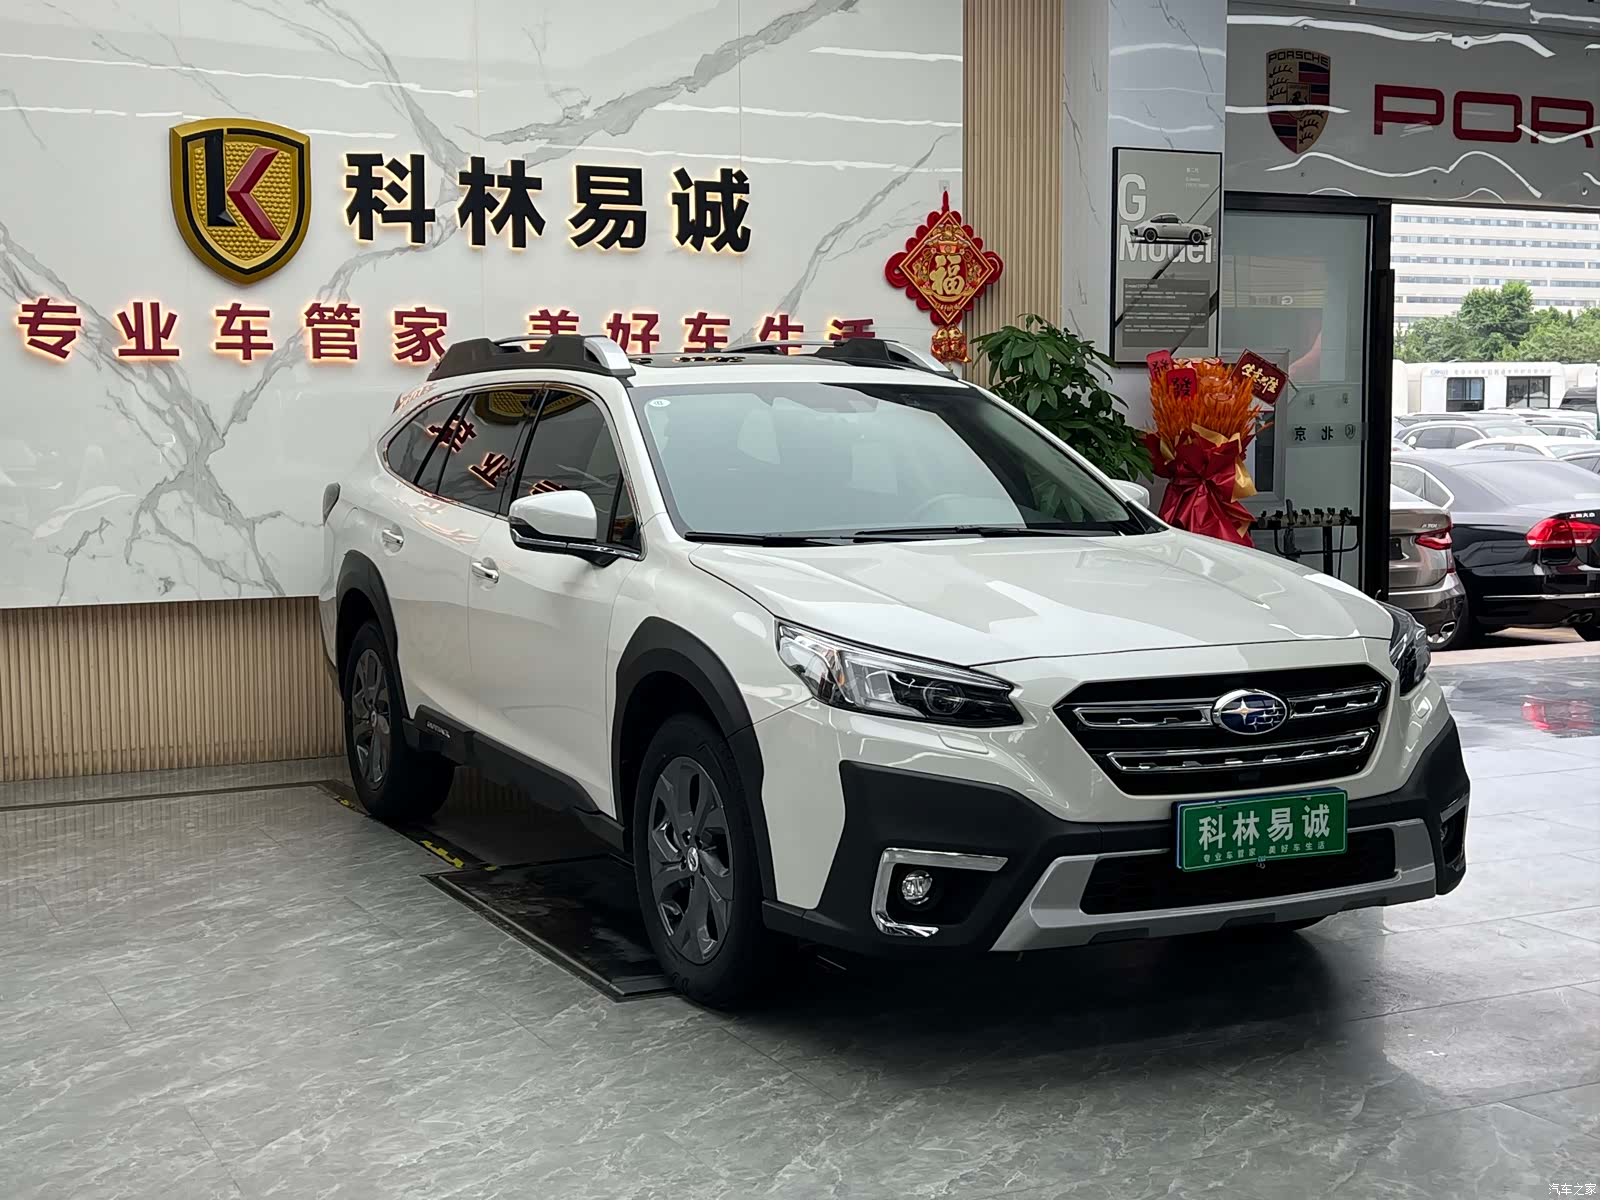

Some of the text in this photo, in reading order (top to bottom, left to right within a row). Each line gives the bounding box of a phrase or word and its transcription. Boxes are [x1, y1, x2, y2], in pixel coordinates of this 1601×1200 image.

[1268, 50, 1330, 67] PORSCHE
[1374, 84, 1594, 148] POR
[344, 152, 752, 252] 科林易诚
[1118, 174, 1146, 222] G
[929, 254, 965, 295] 福
[18, 298, 447, 362] 专业车管家
[1199, 804, 1330, 850] 科林易诚
[1203, 840, 1325, 863] 专业车管家 美好车生活
